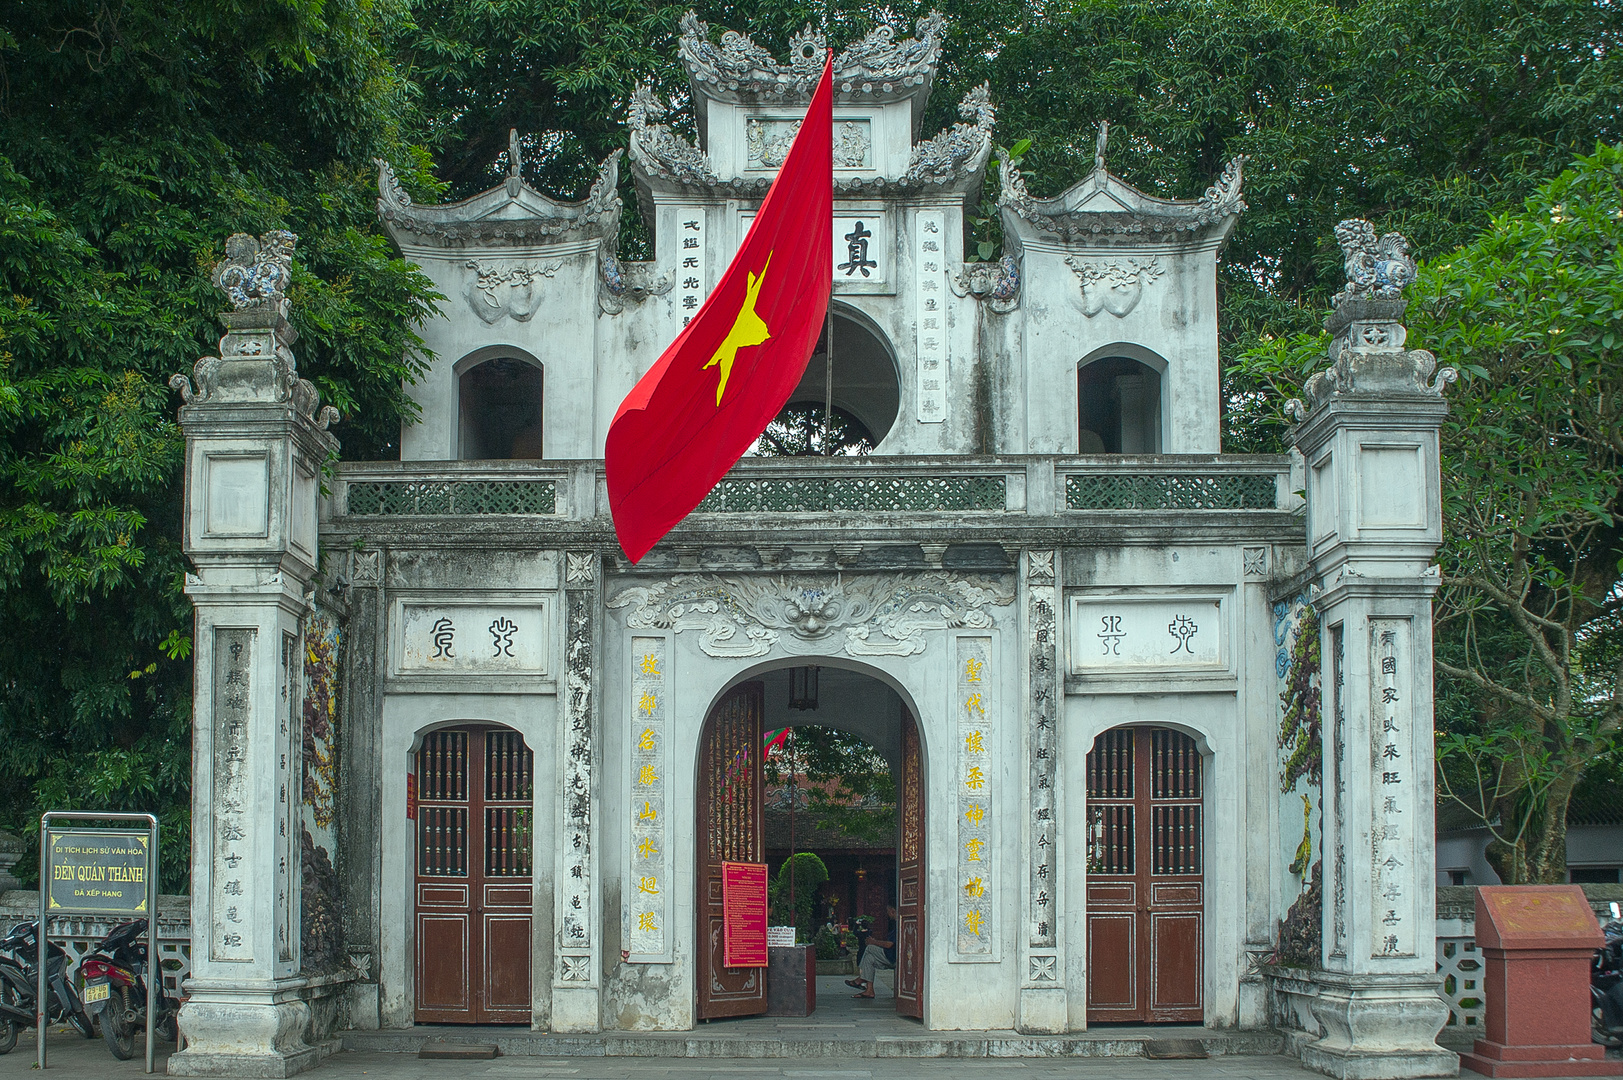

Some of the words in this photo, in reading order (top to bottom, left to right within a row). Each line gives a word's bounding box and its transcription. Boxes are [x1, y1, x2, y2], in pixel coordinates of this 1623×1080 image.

[64, 846, 81, 854] TÍCH
[99, 846, 112, 855] SỬ
[111, 847, 126, 855] VĂN
[54, 857, 76, 880] ĐỀN
[77, 861, 106, 882] QUÁN
[107, 862, 144, 883] THÁNH
[86, 887, 100, 897] XẾP
[101, 890, 122, 899] HẠNG
